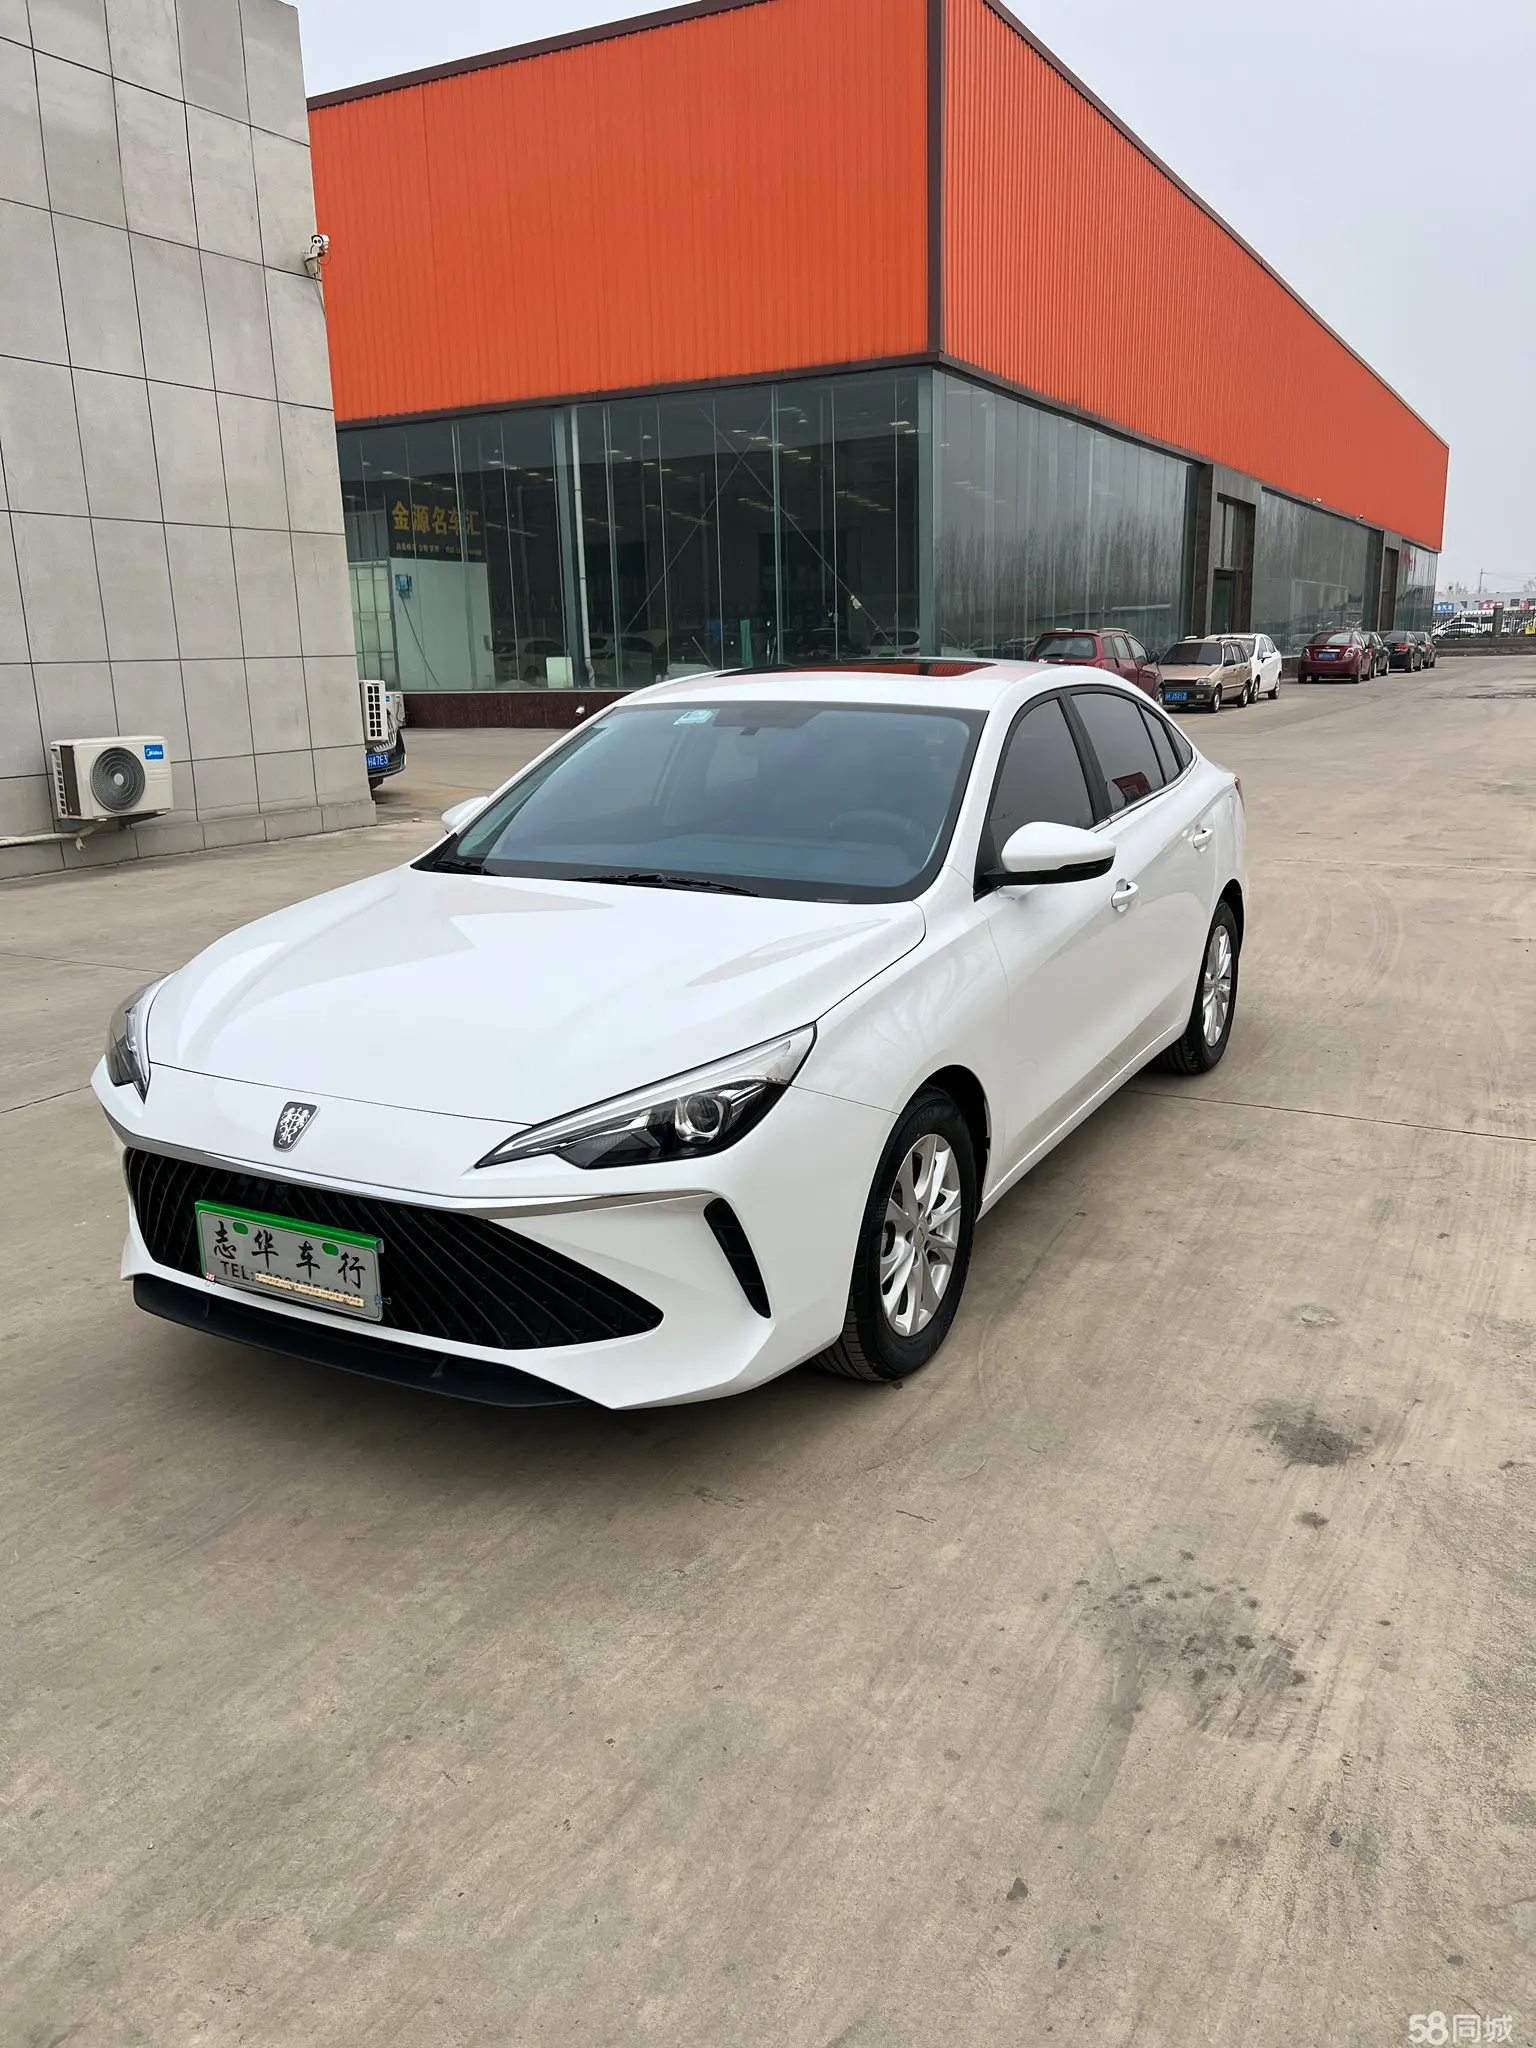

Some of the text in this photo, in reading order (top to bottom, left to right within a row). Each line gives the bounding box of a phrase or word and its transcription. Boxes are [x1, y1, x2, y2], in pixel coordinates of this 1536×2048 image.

[392, 501, 480, 536] 金源名车汇
[213, 1220, 366, 1289] 志华车行
